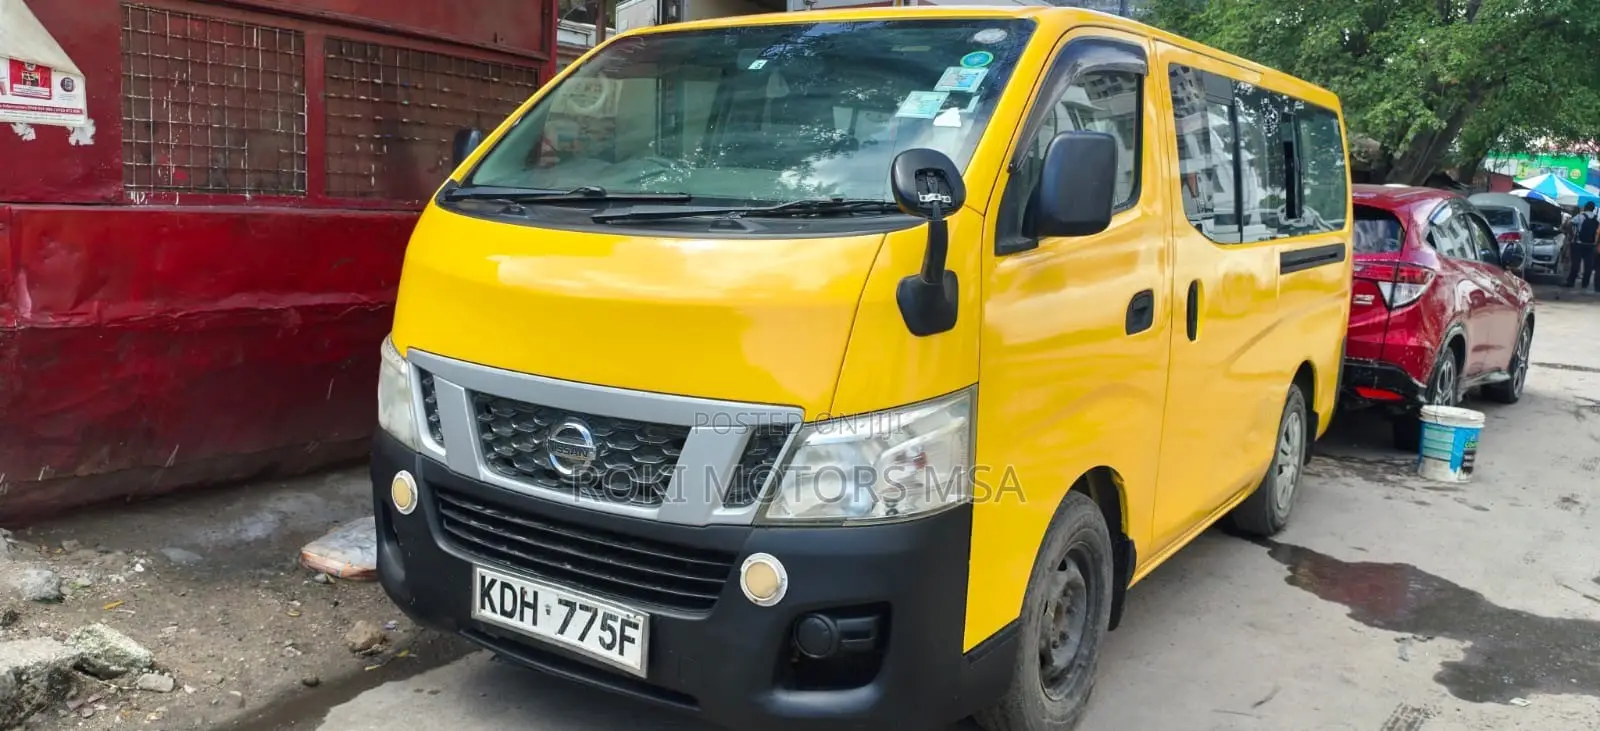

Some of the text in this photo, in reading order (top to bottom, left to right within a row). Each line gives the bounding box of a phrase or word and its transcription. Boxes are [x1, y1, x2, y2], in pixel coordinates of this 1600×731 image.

[548, 440, 588, 458] NISSAN
[480, 575, 640, 656] KDH 775F
